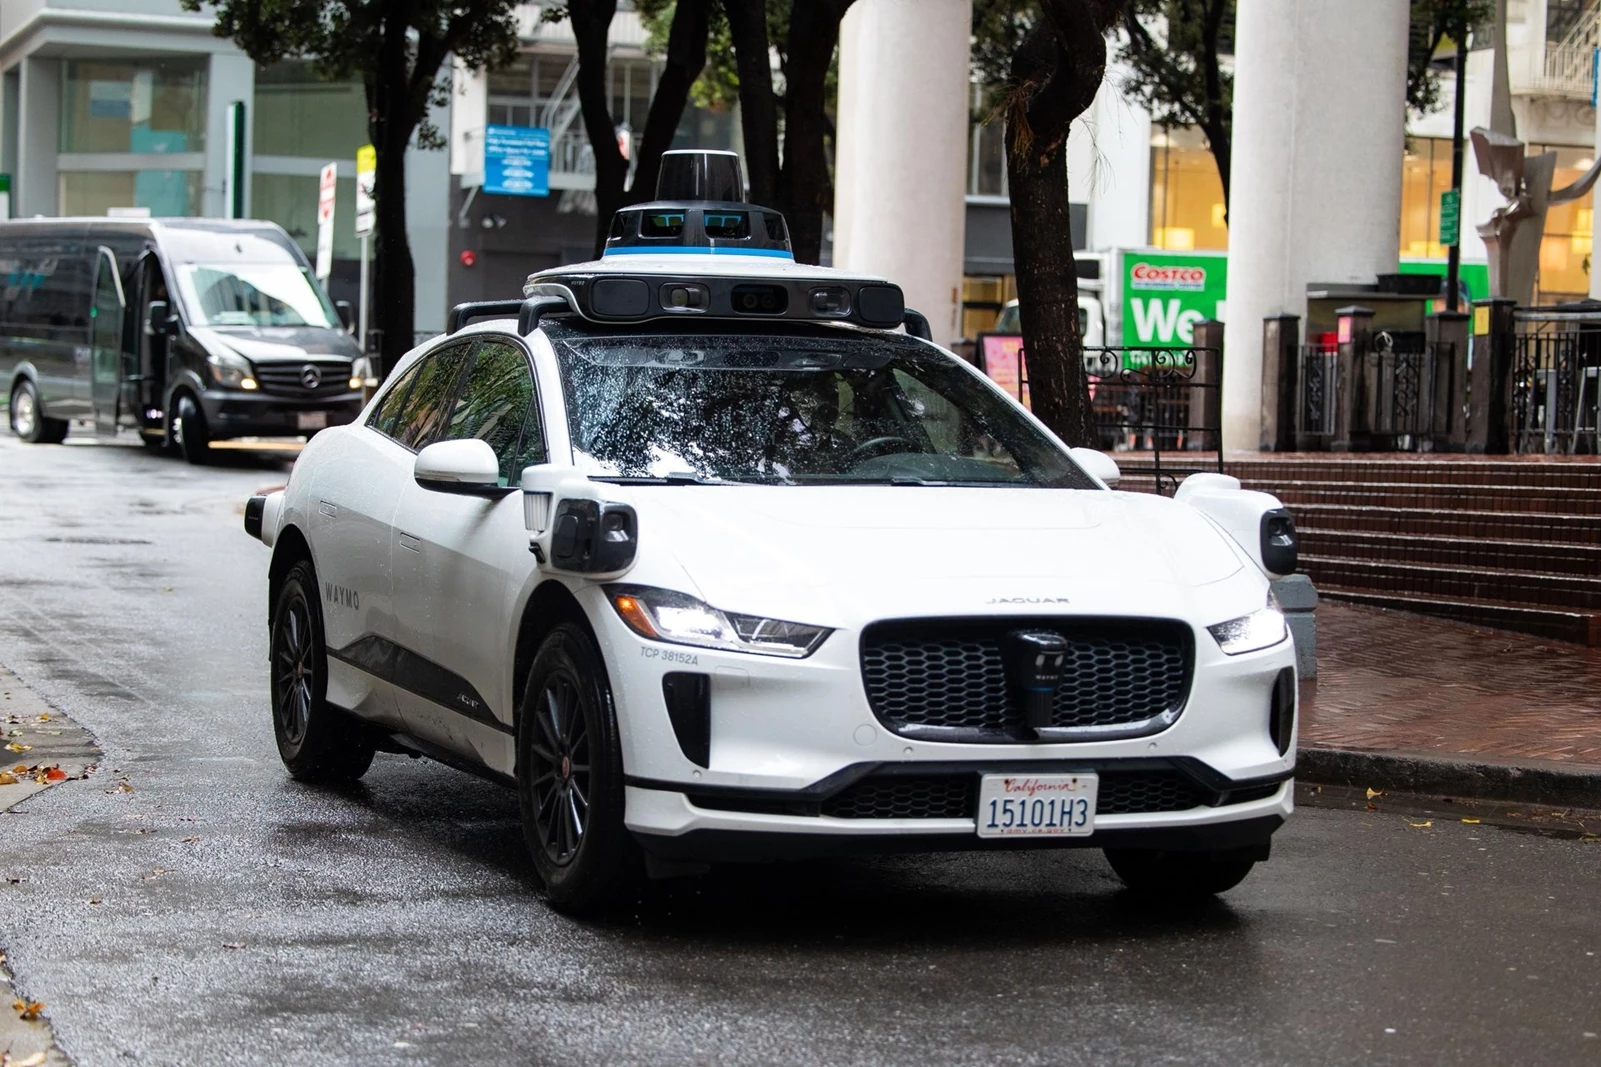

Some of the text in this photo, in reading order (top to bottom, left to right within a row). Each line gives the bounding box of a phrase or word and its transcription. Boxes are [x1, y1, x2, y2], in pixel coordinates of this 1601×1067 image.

[325, 581, 359, 610] WAYMO
[641, 646, 698, 665] TCP 38152A
[1004, 779, 1076, 796] California
[987, 799, 1088, 828] 15101H3
